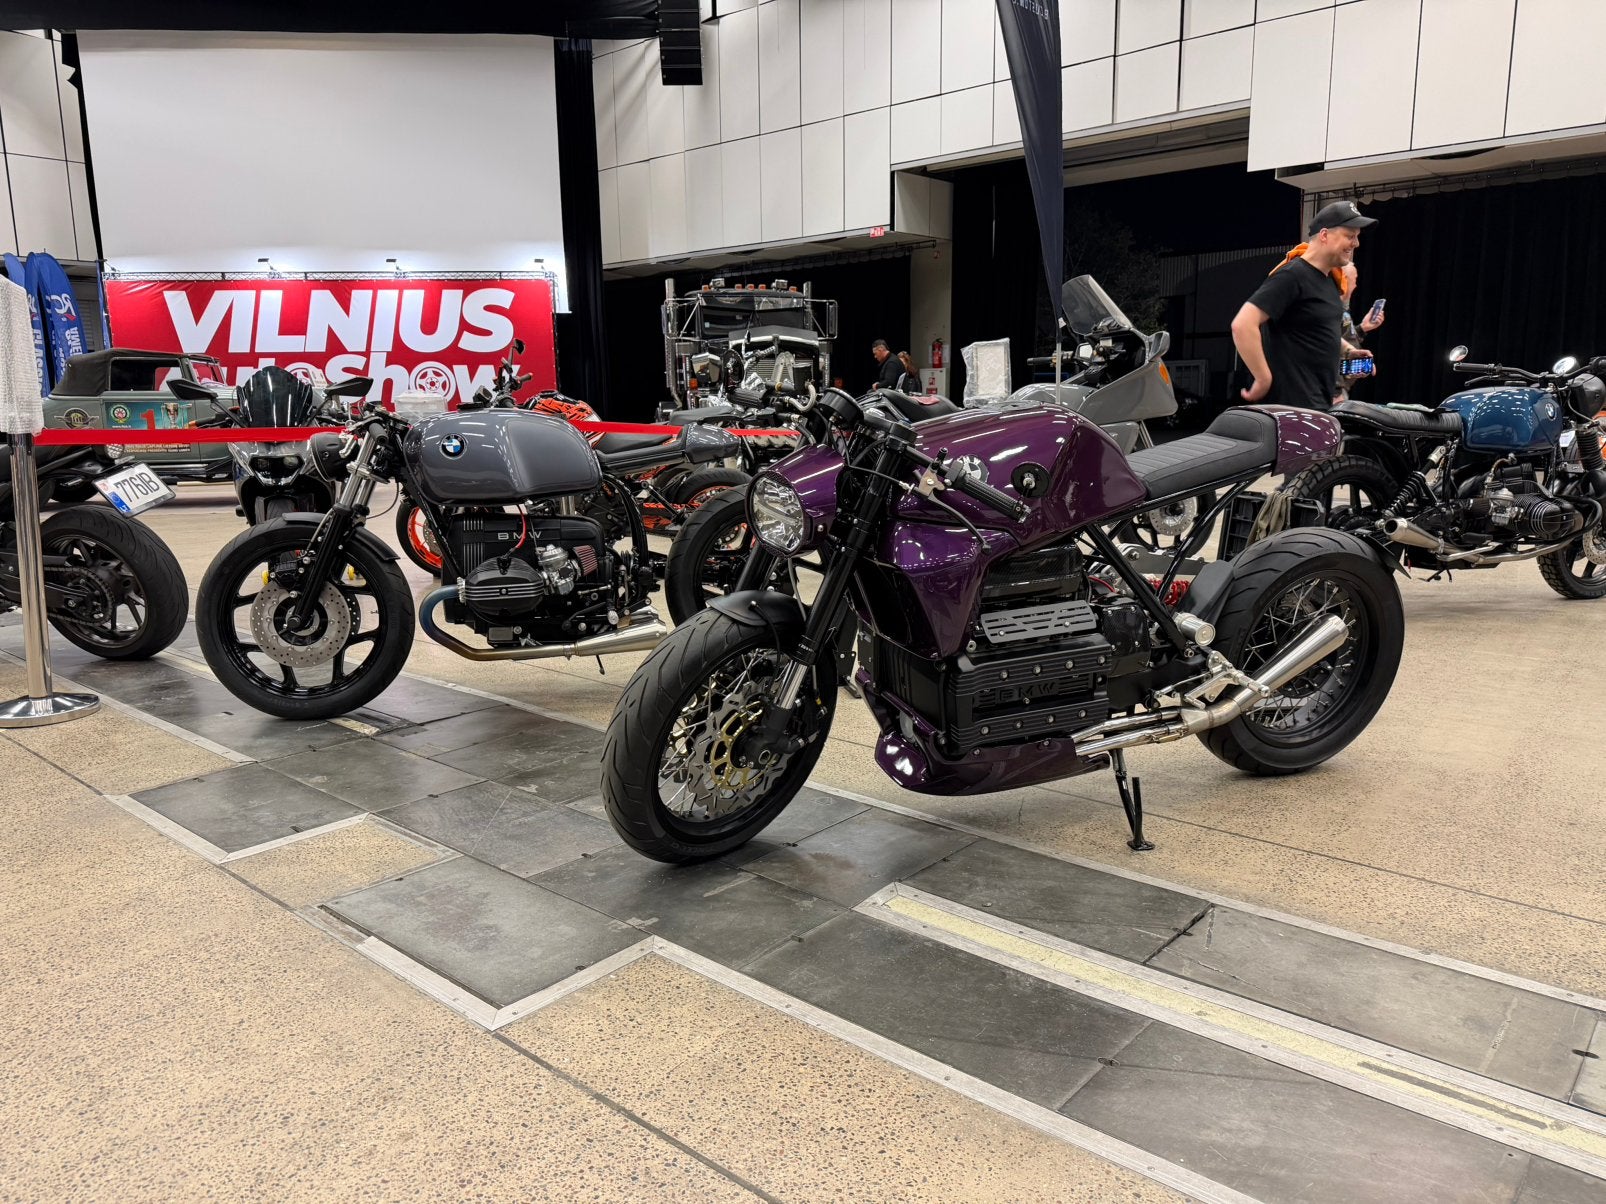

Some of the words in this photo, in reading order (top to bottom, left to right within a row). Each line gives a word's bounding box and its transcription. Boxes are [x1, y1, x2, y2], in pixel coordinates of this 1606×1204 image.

[163, 288, 515, 353] VILNIUS
[498, 531, 541, 540] BMW
[1000, 682, 1056, 702] BMW
